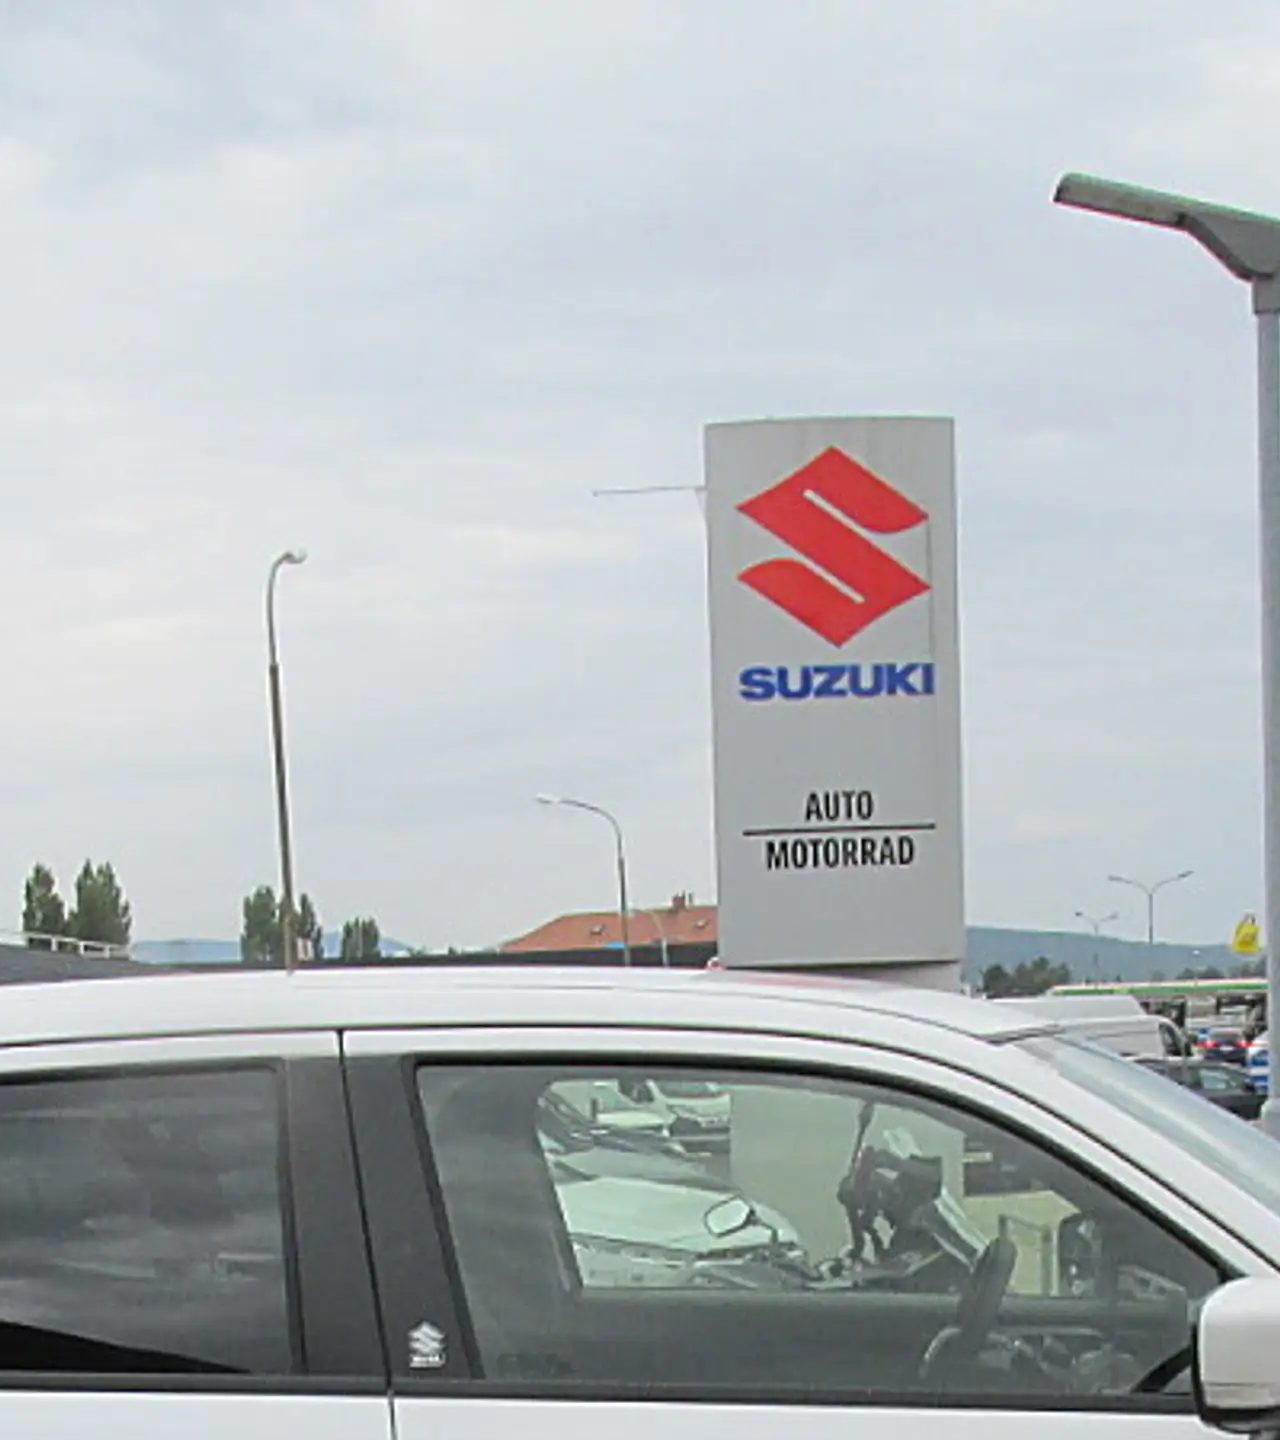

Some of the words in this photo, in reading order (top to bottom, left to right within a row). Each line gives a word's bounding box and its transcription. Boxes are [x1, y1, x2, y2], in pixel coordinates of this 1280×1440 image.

[739, 662, 935, 701] SUZUKI
[805, 790, 874, 821] AUTO
[766, 835, 915, 870] MOTORRAD
